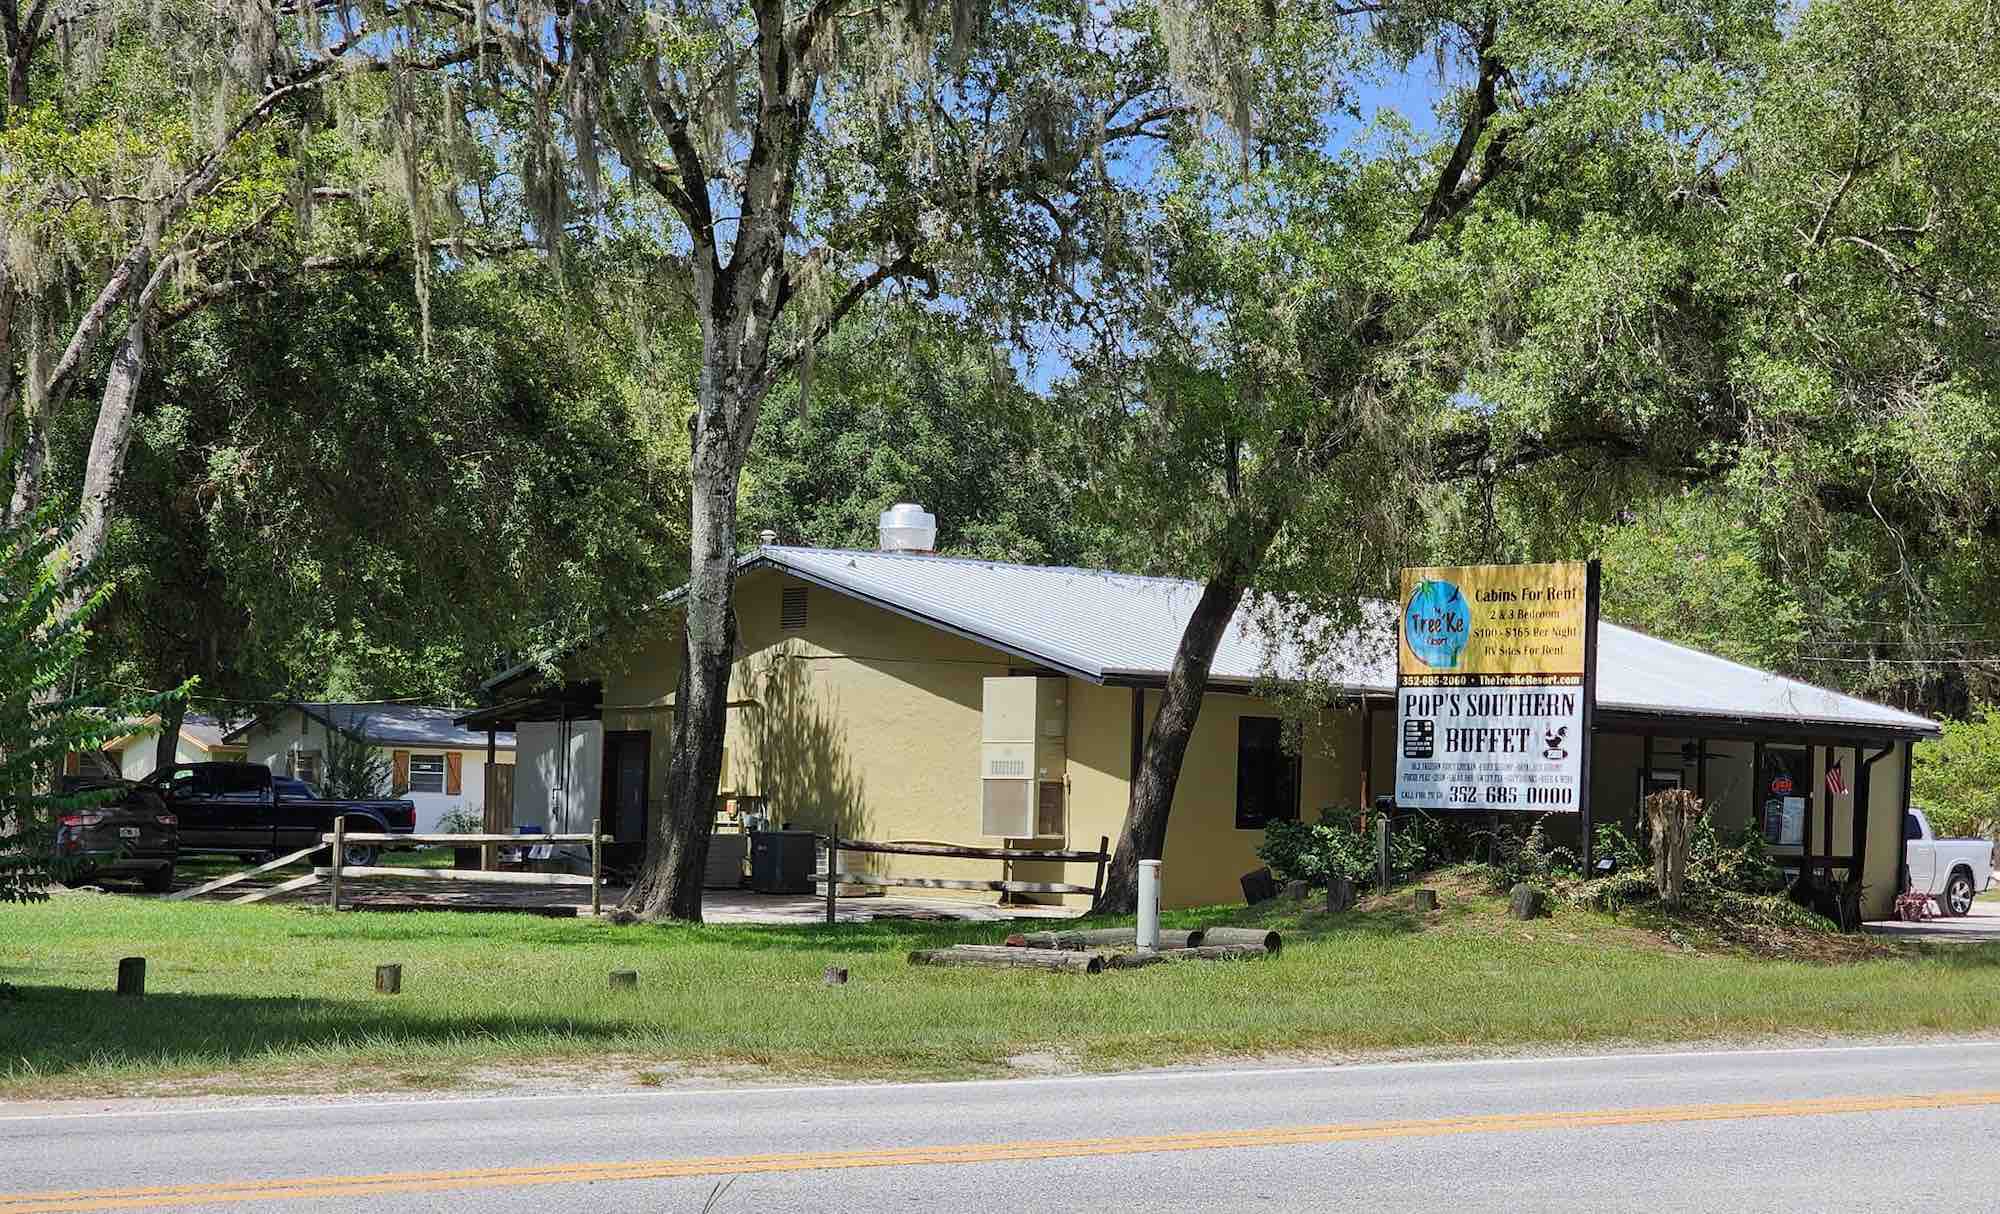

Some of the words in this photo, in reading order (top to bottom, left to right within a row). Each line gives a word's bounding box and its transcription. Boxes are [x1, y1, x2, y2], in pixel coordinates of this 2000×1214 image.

[1475, 588, 1517, 602] Cabins
[1522, 588, 1543, 601] For
[1547, 587, 1576, 601] Rent
[1490, 610, 1496, 620] 2
[1509, 609, 1514, 619] 3
[1517, 609, 1560, 619] Bedroom
[1505, 627, 1530, 638] $165
[1533, 627, 1548, 637] Per
[1553, 626, 1576, 638] Night
[1485, 647, 1496, 656] RV
[1499, 646, 1521, 656] Sites
[1524, 646, 1539, 655] For
[1542, 645, 1564, 655] Rent
[1401, 676, 1467, 686] 352-685-2060
[1480, 675, 1580, 685] TheTreeKeResort.com
[1404, 694, 1461, 717] POP'S
[1466, 693, 1576, 717] SOUTHERN
[1445, 727, 1531, 753] BUFFET
